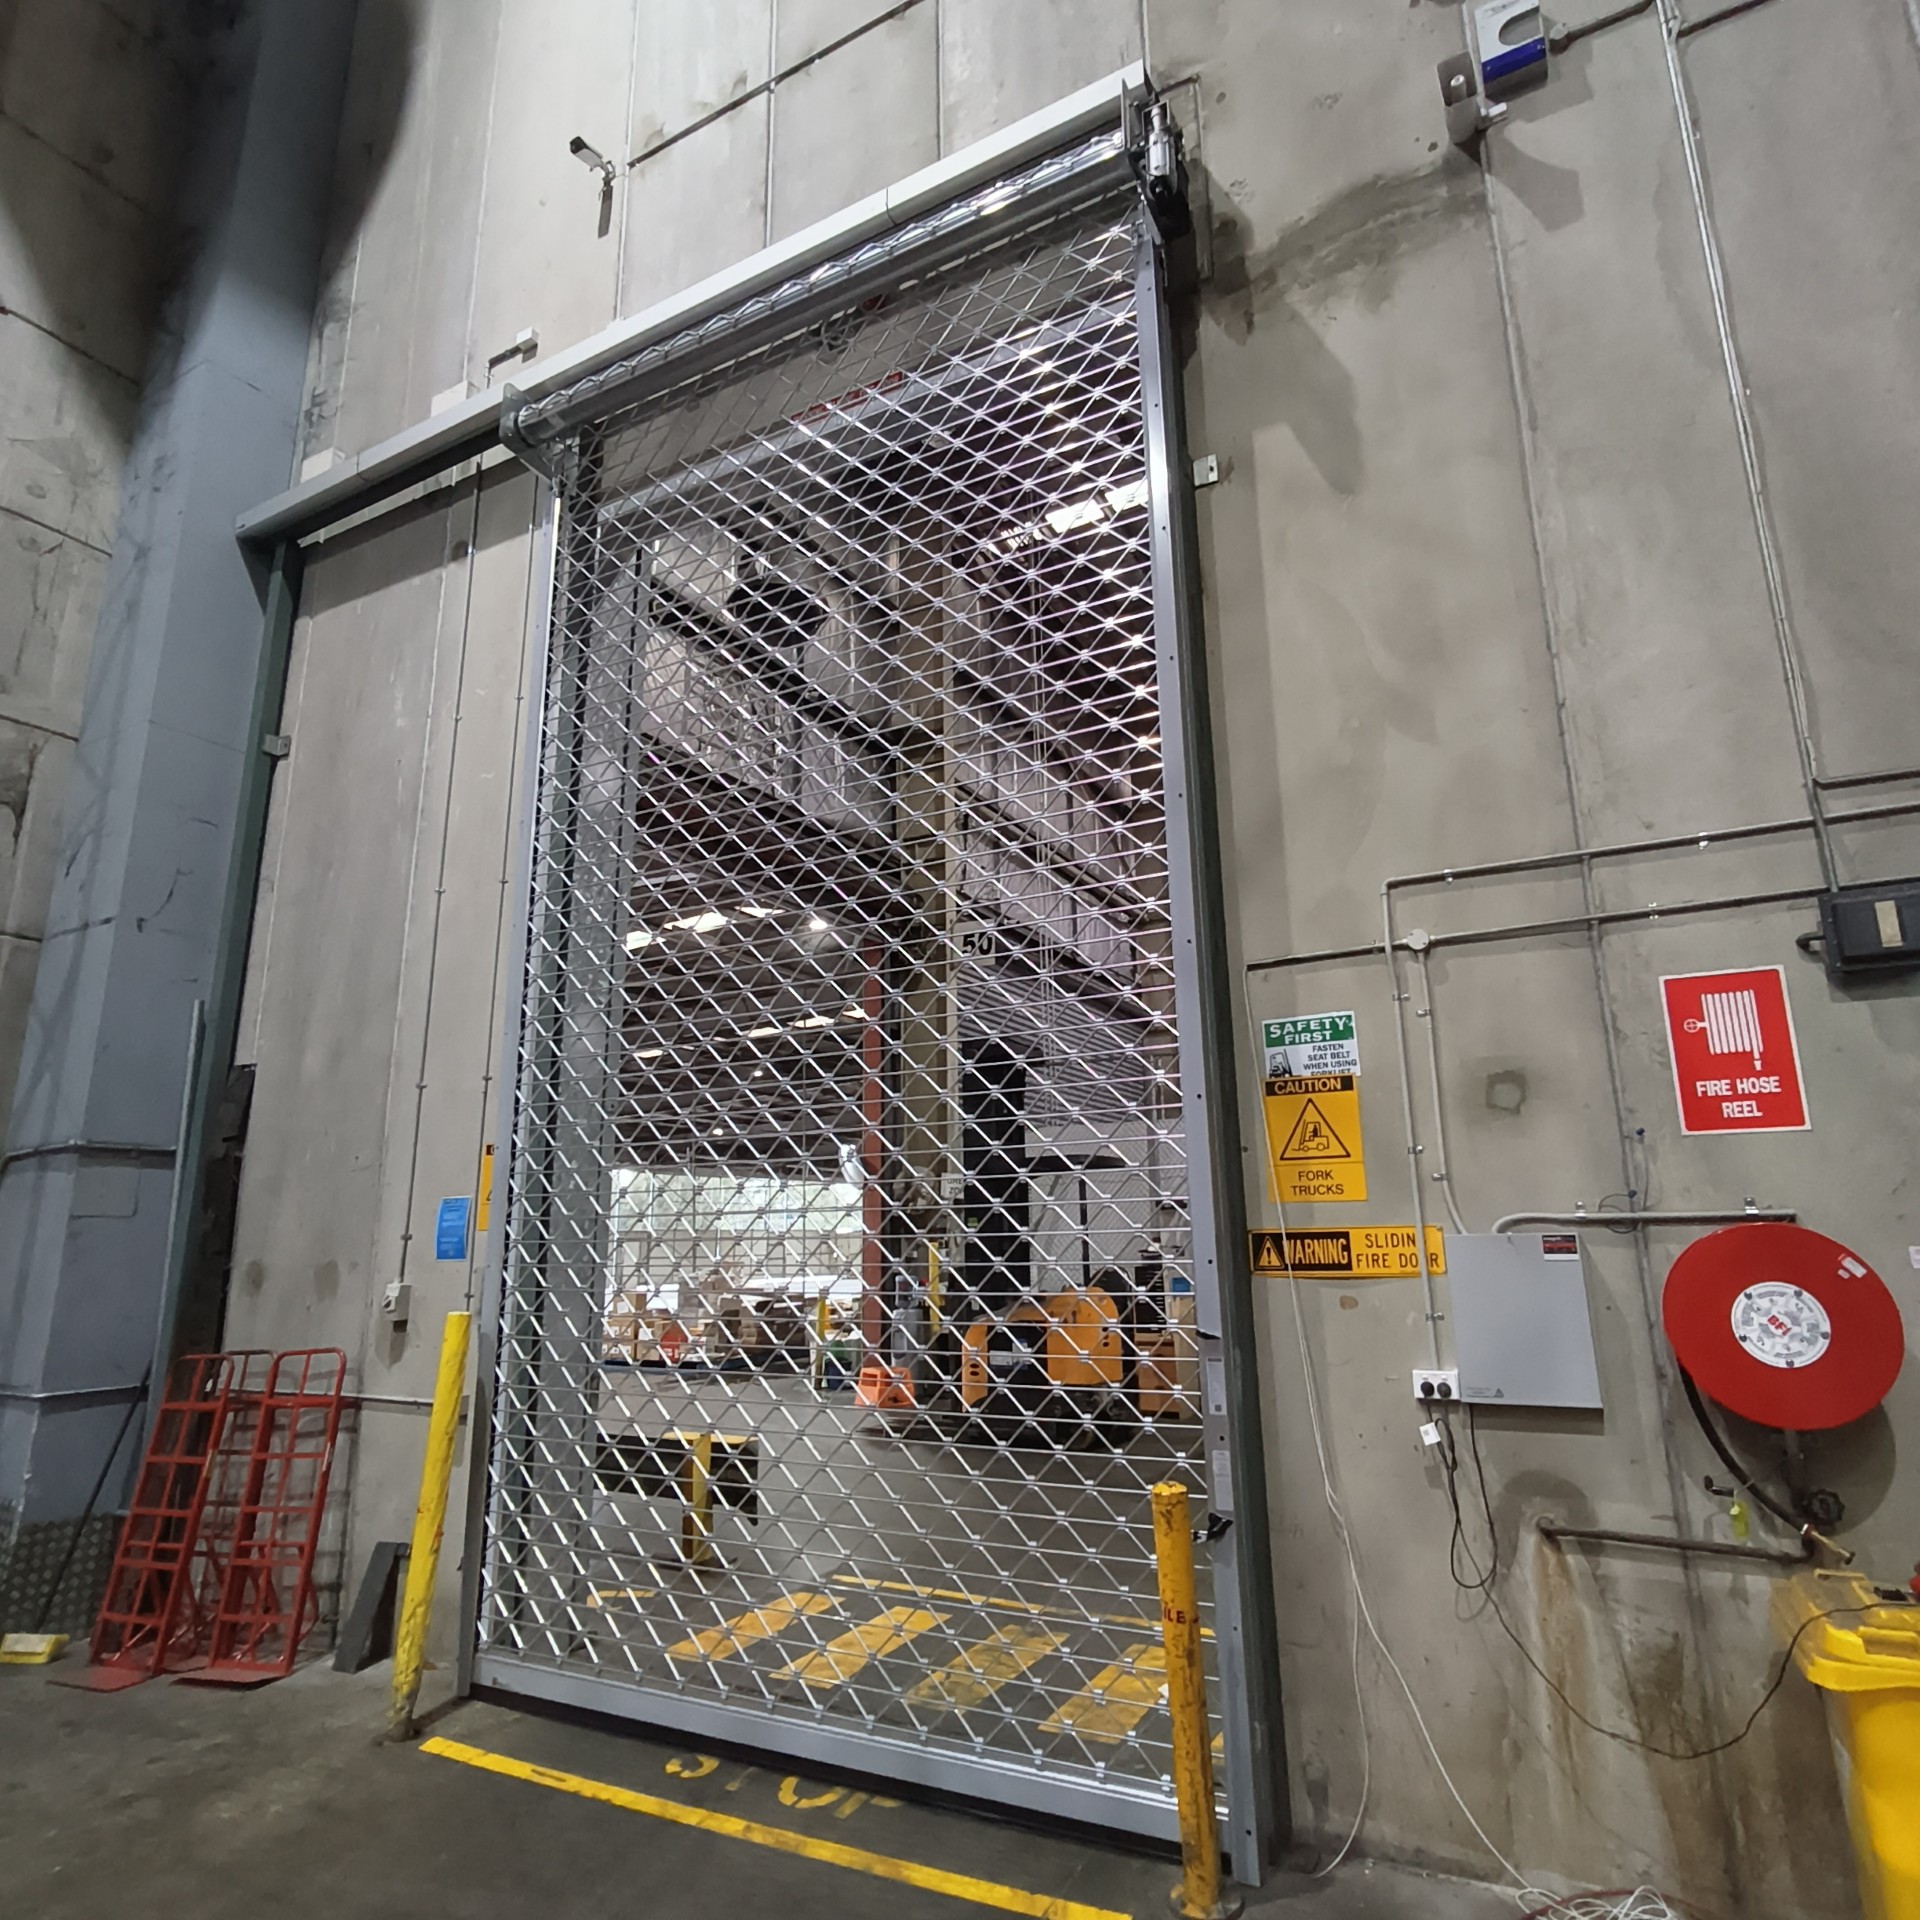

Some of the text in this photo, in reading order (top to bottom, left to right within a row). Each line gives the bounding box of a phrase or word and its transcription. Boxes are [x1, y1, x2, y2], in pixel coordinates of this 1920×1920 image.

[962, 932, 993, 956] 50
[1269, 1016, 1347, 1038] SAFETY
[1284, 1030, 1333, 1045] FIRST
[1307, 1050, 1351, 1062] SEAT BELT
[1312, 1043, 1345, 1053] FASTEN
[1303, 1059, 1358, 1071] WHEN USING
[1274, 1077, 1342, 1095] CAUTION
[1695, 1076, 1782, 1097] FIRE HOSE
[1721, 1100, 1763, 1118] REEL
[1298, 1169, 1334, 1181] FORK
[1290, 1183, 1345, 1197] TRUCKS
[1365, 1232, 1418, 1248] SLIDIN
[1283, 1238, 1349, 1265] WARNING
[1356, 1252, 1440, 1269] FIRE DOR
